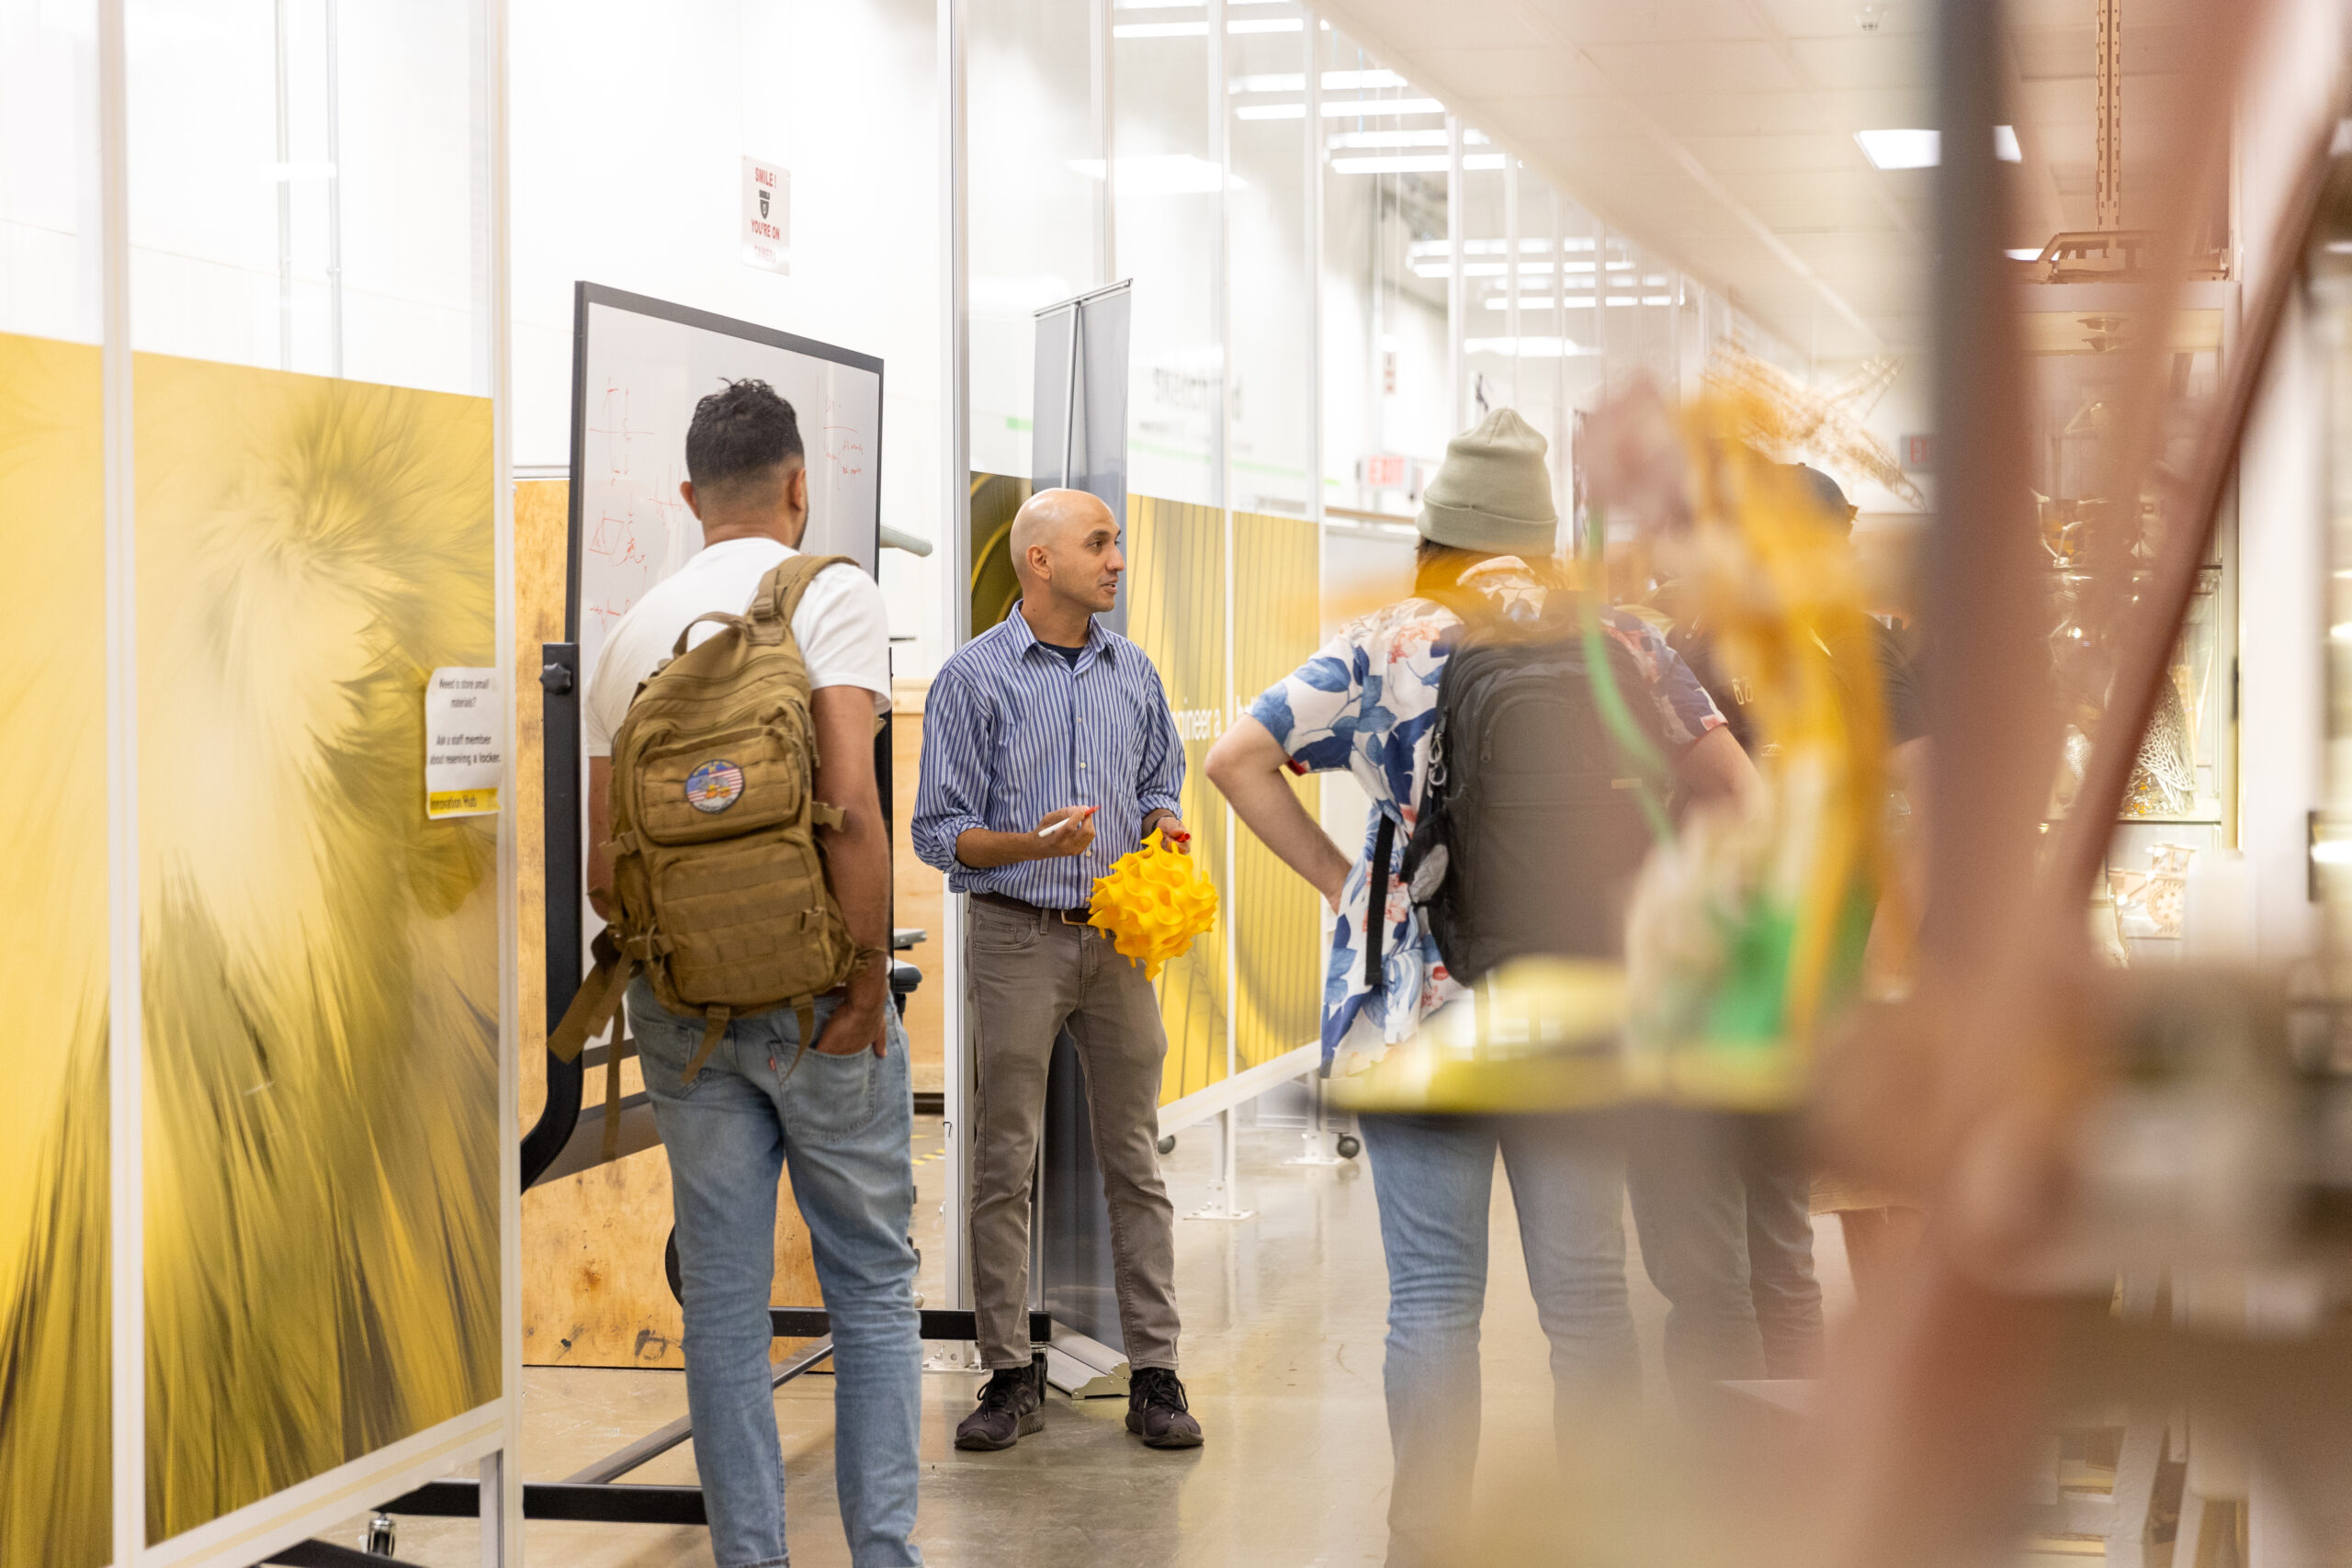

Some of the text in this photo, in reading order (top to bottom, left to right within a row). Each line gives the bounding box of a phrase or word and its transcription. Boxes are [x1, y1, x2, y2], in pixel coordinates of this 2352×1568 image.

[751, 219, 780, 241] YOU'RE ON
[439, 678, 455, 689] Need
[461, 680, 474, 689] store
[475, 678, 489, 689] small
[451, 696, 477, 707] materials?
[1214, 708, 1222, 739] a
[436, 735, 446, 745] Ask
[451, 735, 464, 745] staff
[465, 735, 492, 745] member
[430, 755, 445, 765] about
[446, 755, 471, 766] reserving
[473, 756, 478, 764] a
[463, 795, 478, 808] Hub
